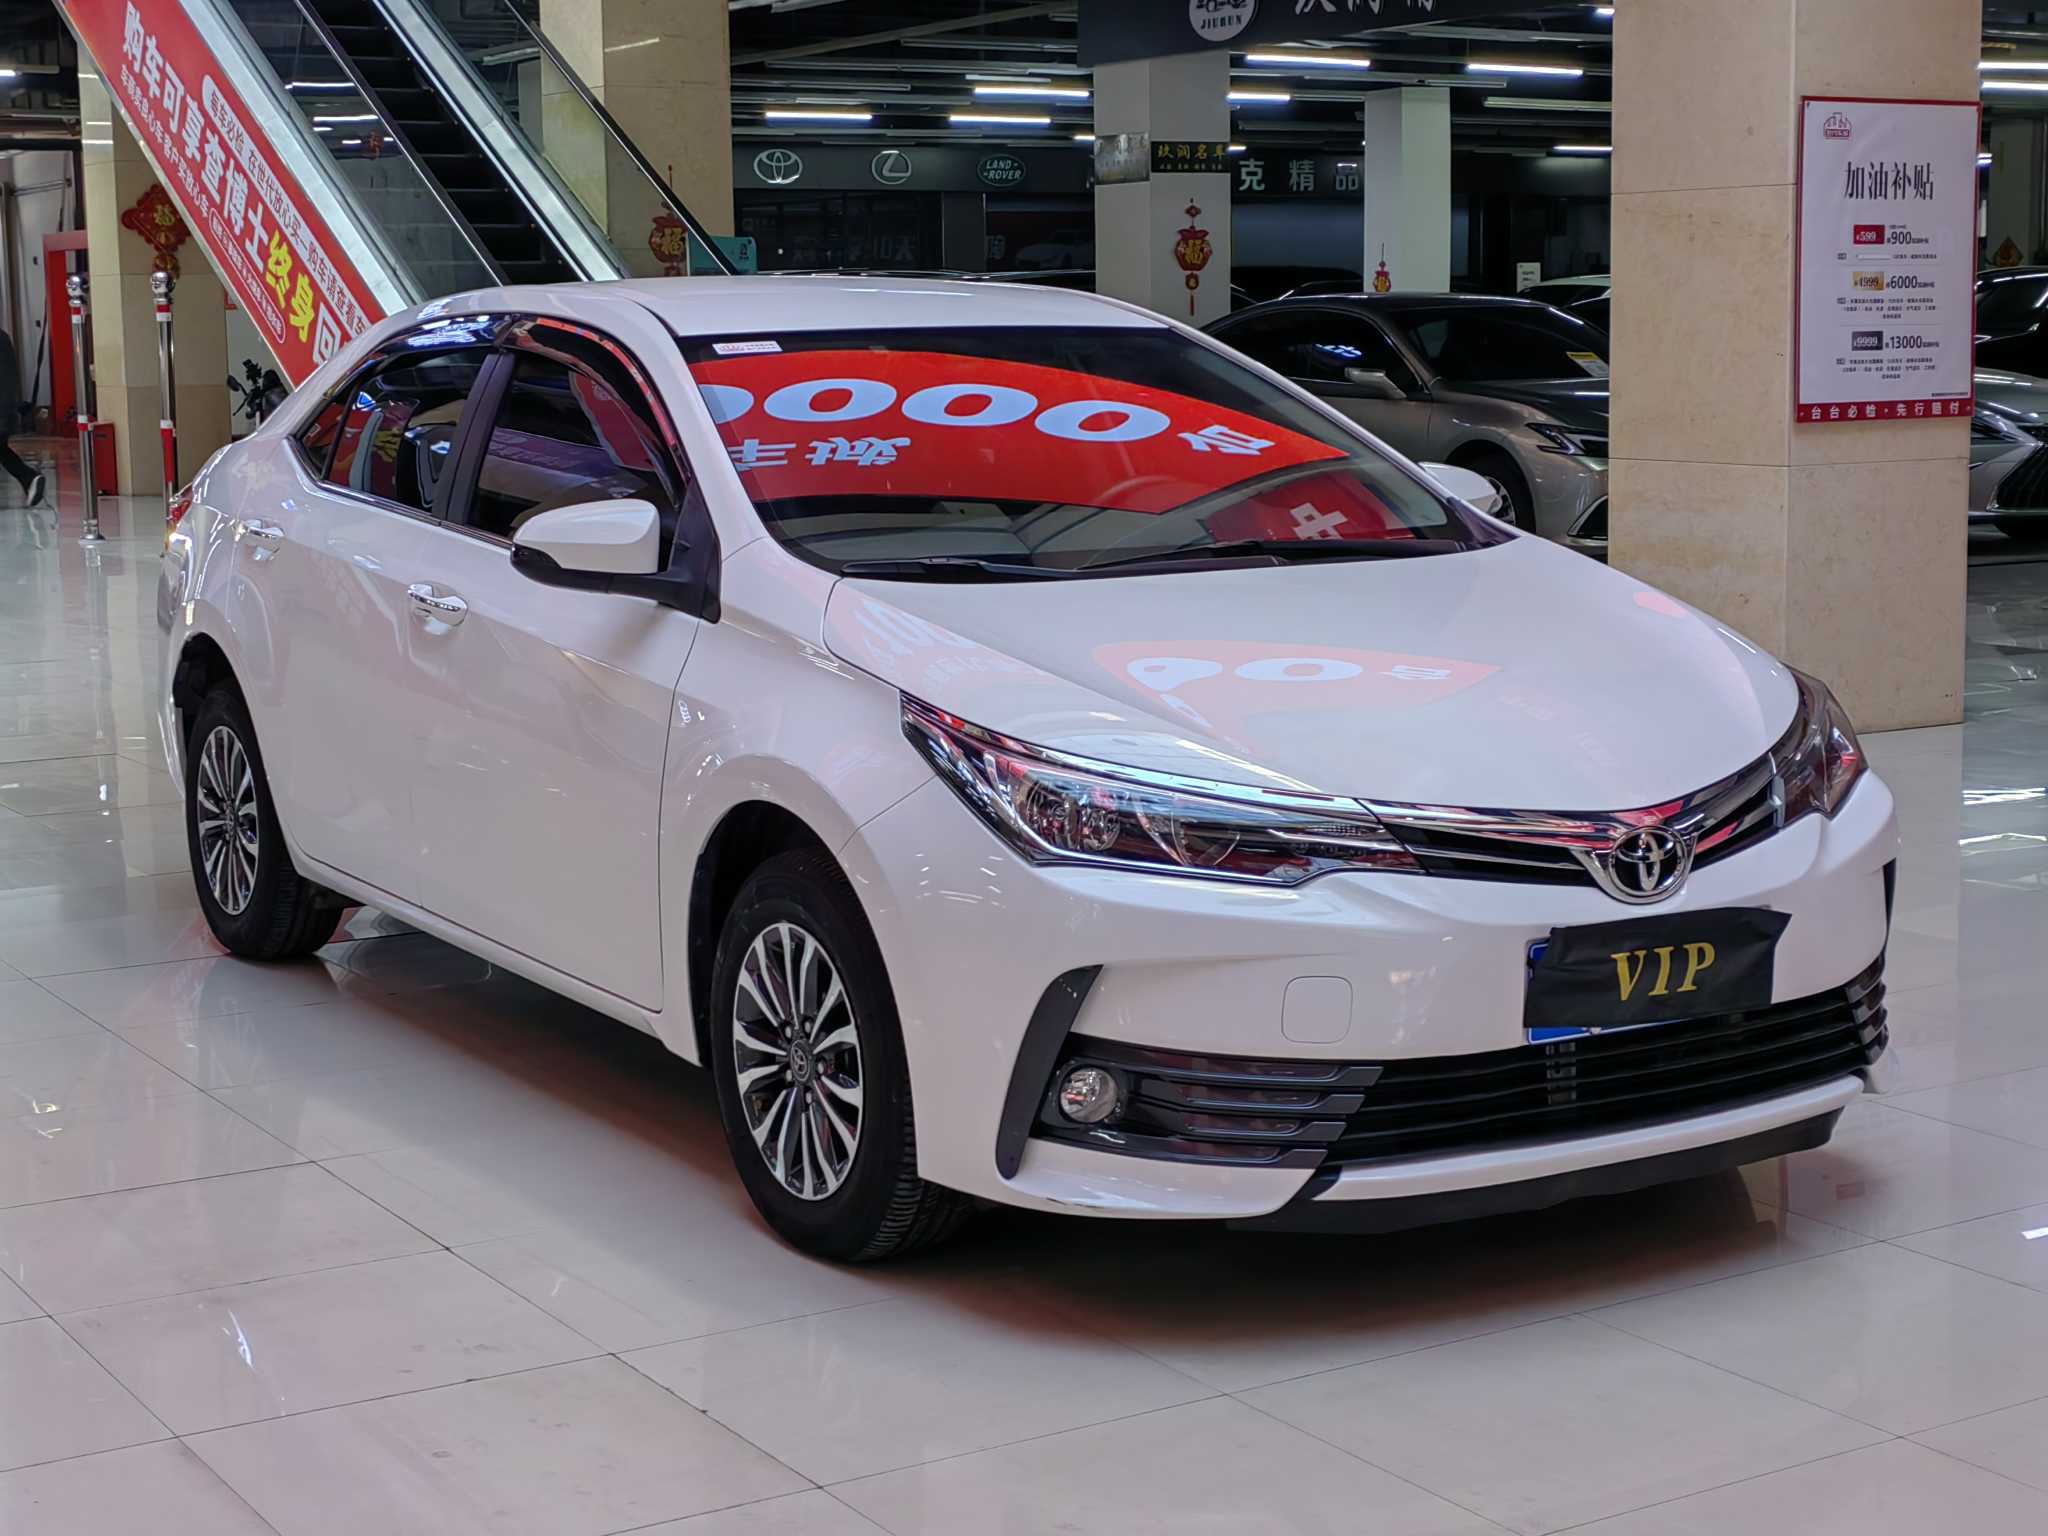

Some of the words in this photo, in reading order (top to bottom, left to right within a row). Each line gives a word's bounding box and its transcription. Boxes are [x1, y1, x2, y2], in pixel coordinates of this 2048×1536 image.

[1844, 161, 1934, 200] 加油补贴
[1610, 942, 1716, 1001] VIP
